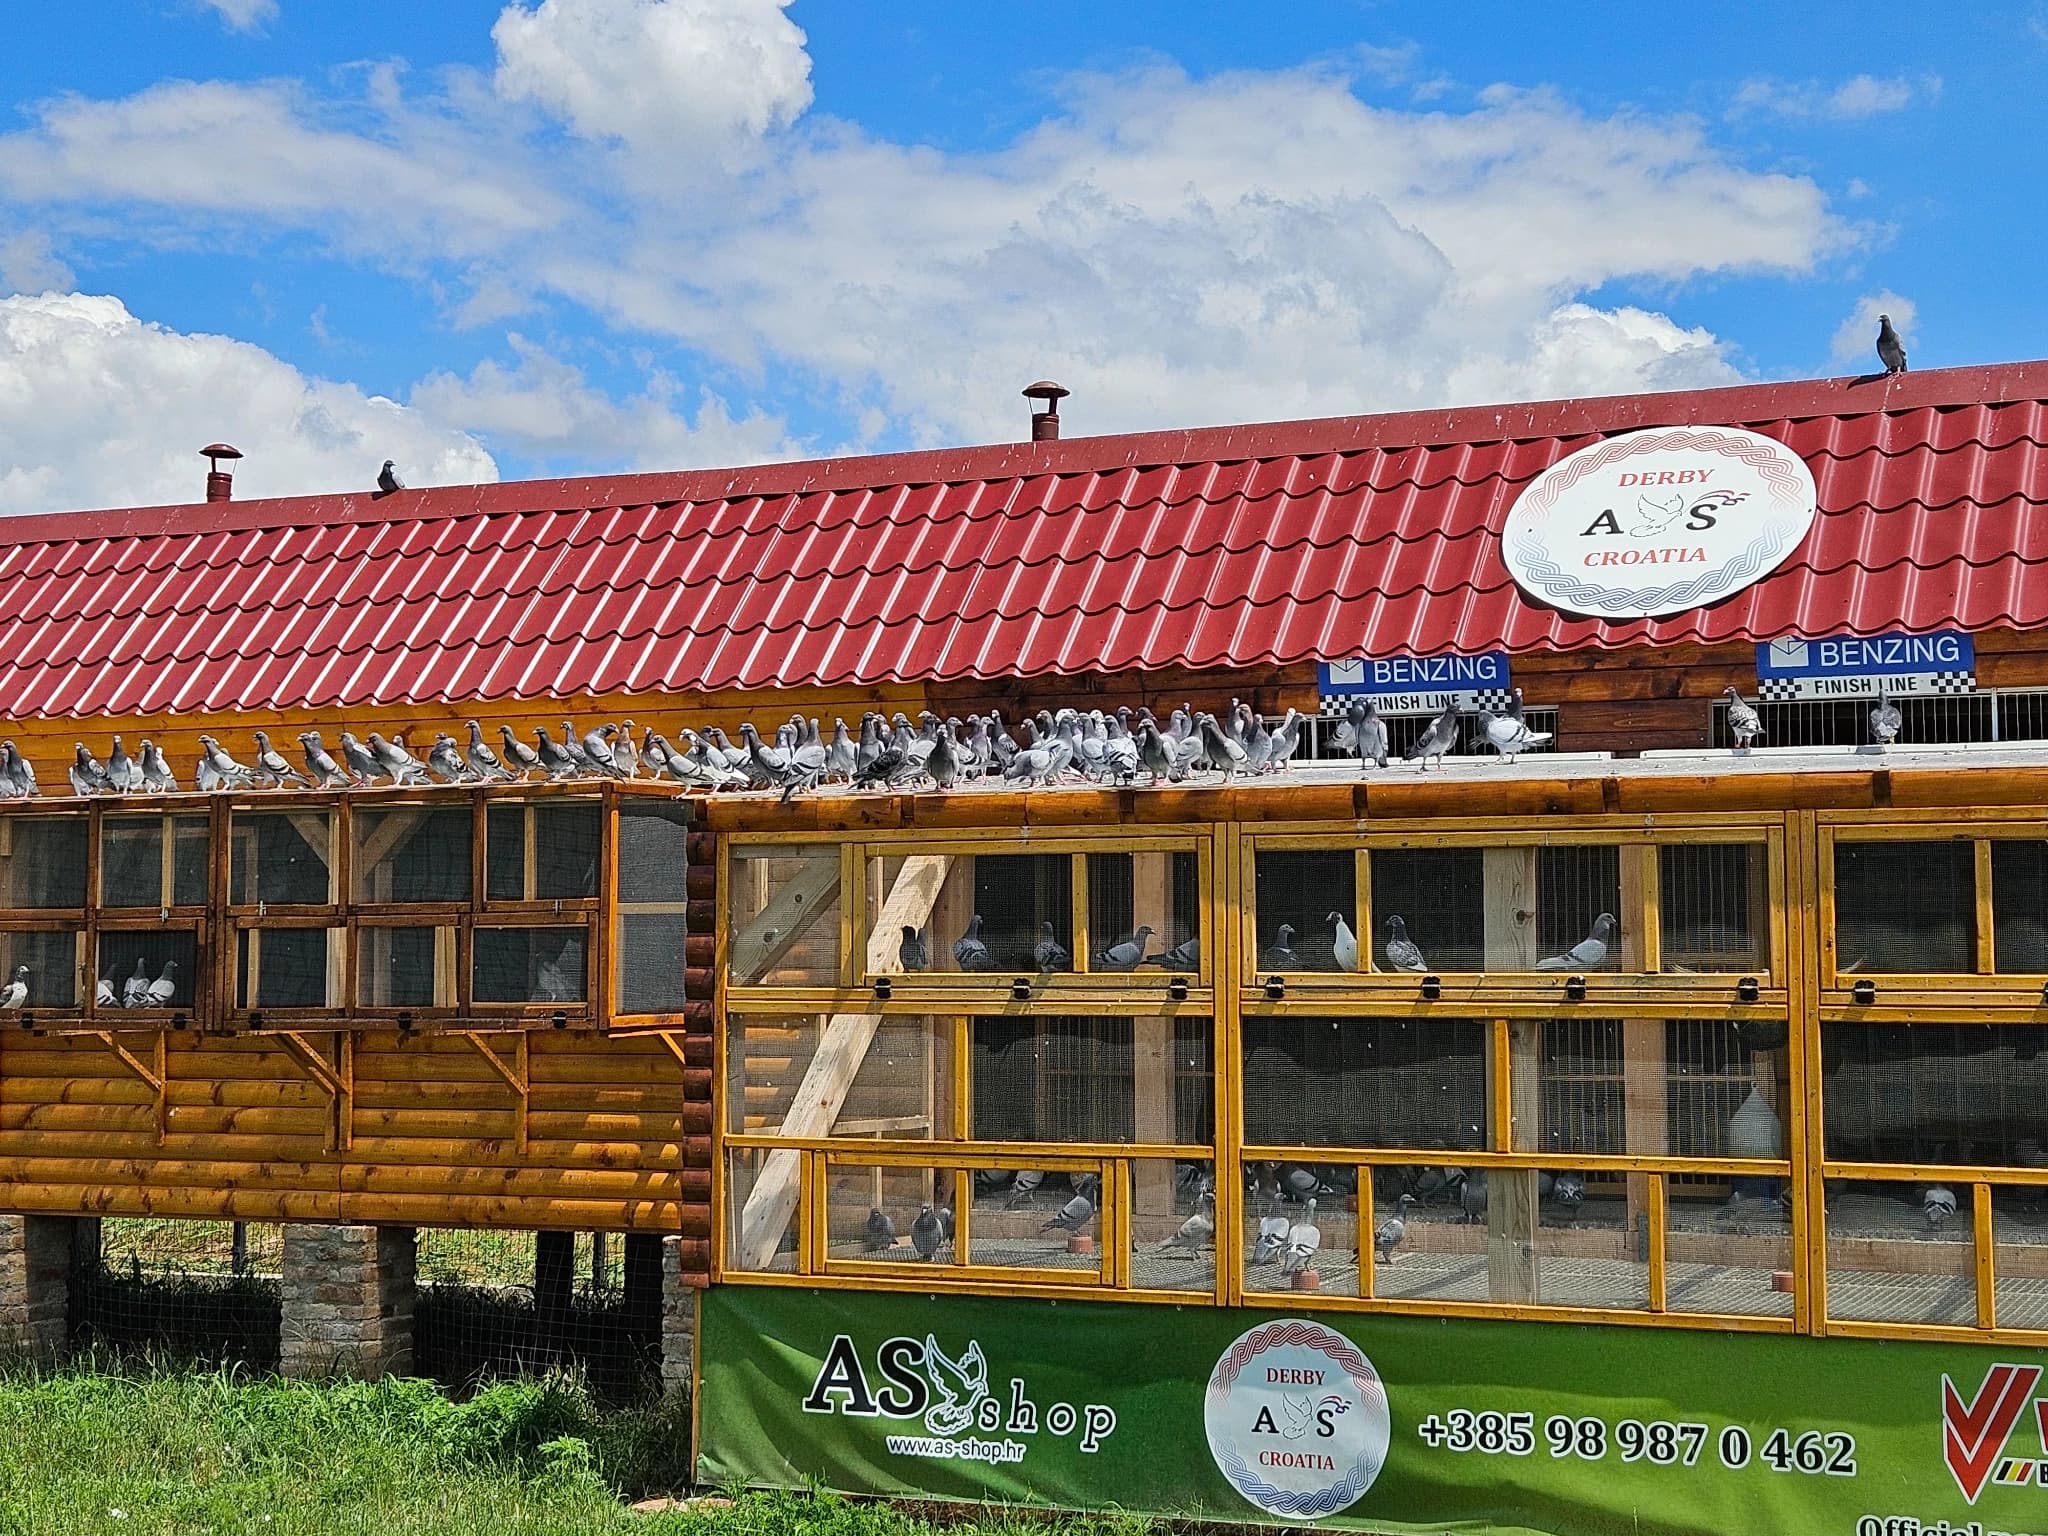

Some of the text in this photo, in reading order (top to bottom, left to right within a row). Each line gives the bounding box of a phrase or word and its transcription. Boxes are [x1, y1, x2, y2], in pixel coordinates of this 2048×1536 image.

[1618, 468, 1714, 487] DERBY
[1579, 503, 1718, 536] A S
[1583, 547, 1707, 567] CROATIA
[1821, 636, 1959, 667] BENZING
[1373, 656, 1497, 683] BENZING
[1814, 676, 1918, 694] FINISH LINE
[1266, 1367, 1325, 1385] DERBY
[804, 1335, 1116, 1451] AS shop
[1251, 1406, 1335, 1437] A S
[886, 1436, 1026, 1463] www.as-shop.hr
[1419, 1409, 1857, 1476] +385 98 987 0 462
[1259, 1451, 1335, 1470] CROATIA
